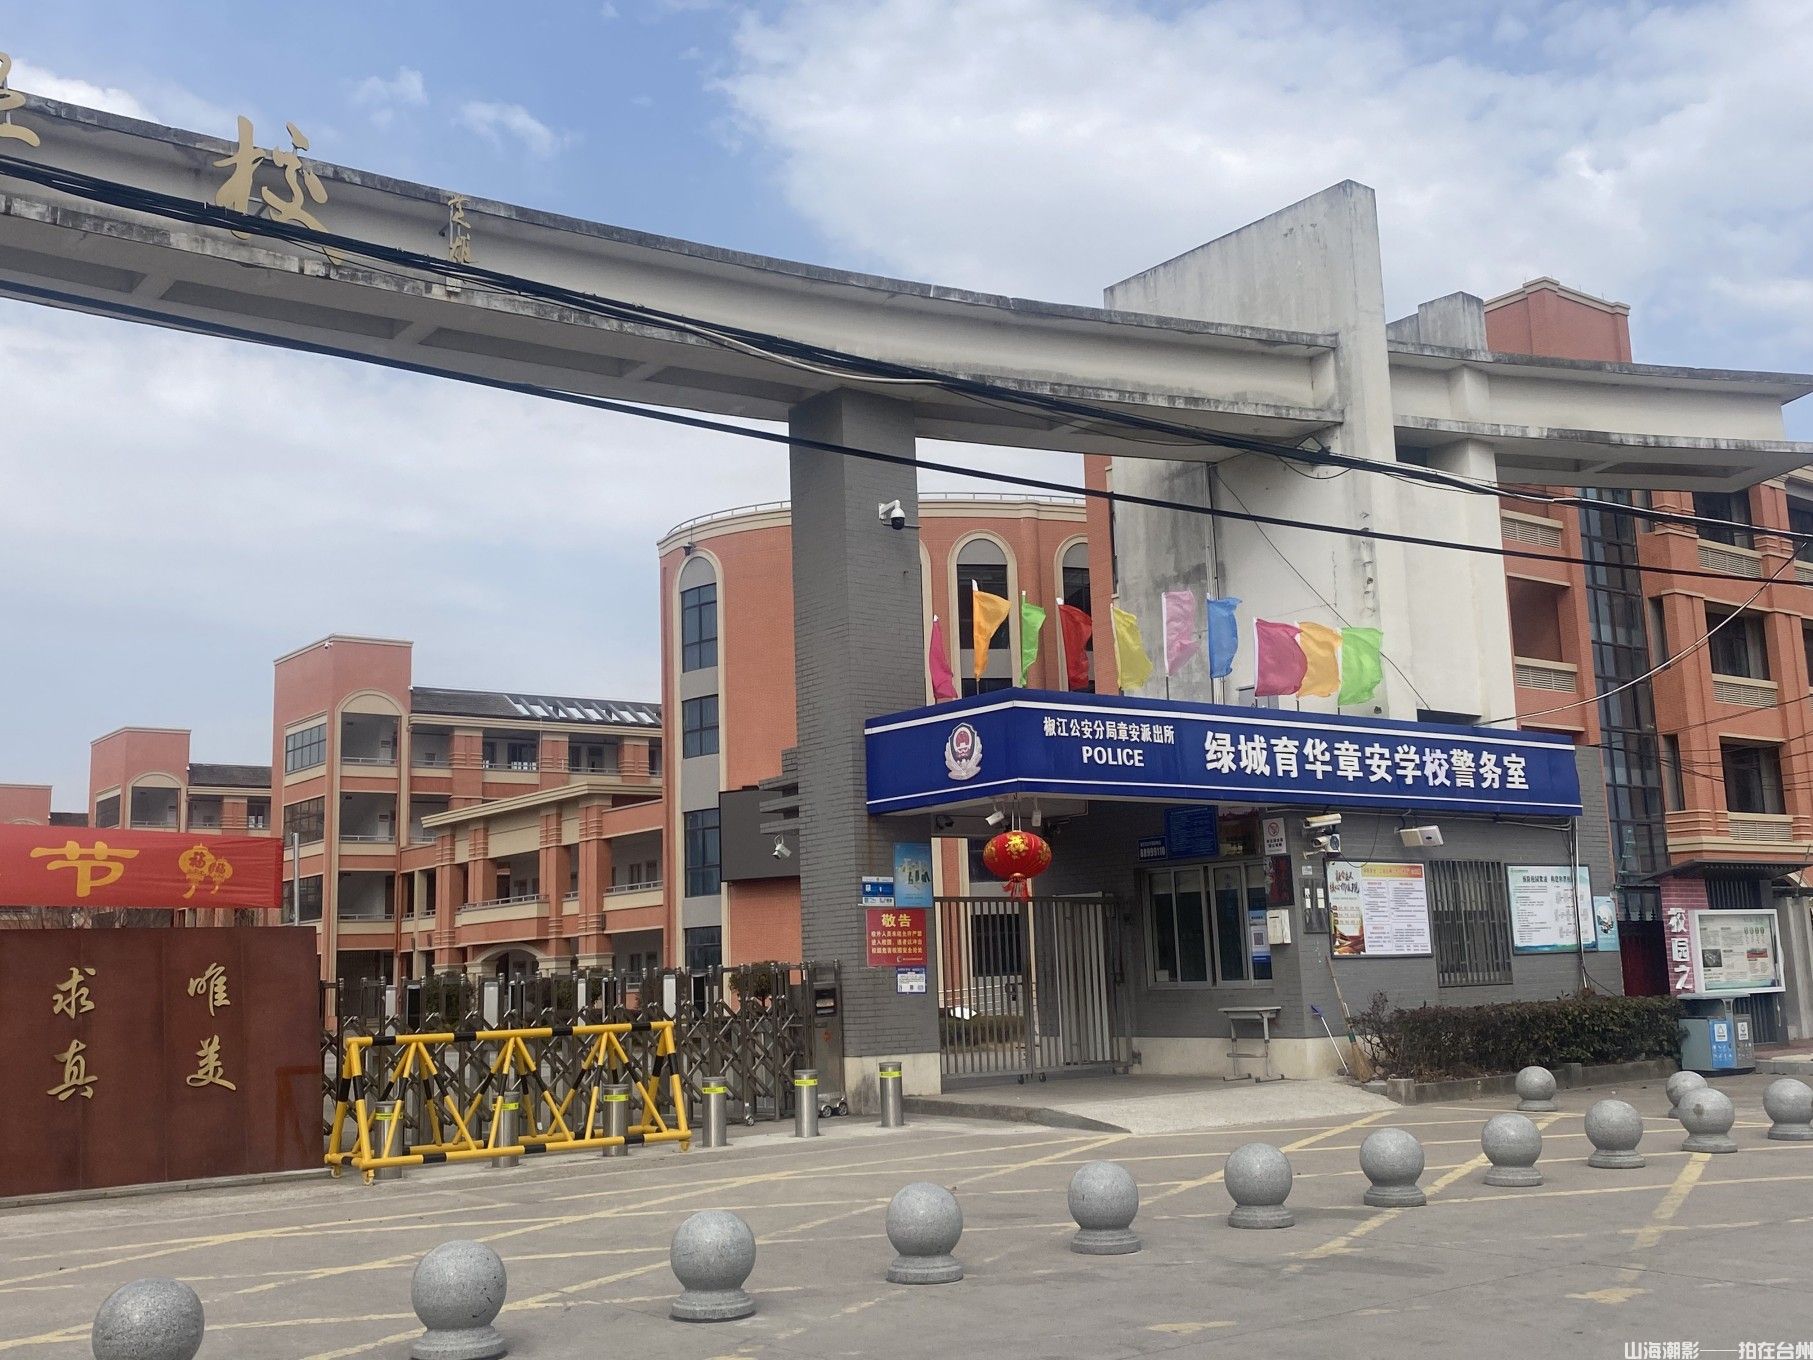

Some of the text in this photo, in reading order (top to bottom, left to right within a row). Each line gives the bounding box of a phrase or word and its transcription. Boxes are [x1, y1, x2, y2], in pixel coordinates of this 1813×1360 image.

[1043, 716, 1176, 745] 椒江公安分局章安派出所
[1081, 745, 1145, 768] POLICE
[1204, 730, 1530, 791] 绿城育华章安学校警务室
[29, 840, 140, 898] 节
[881, 913, 912, 928] 敬告
[46, 966, 99, 1102] 求真
[186, 962, 237, 1091] 唯美
